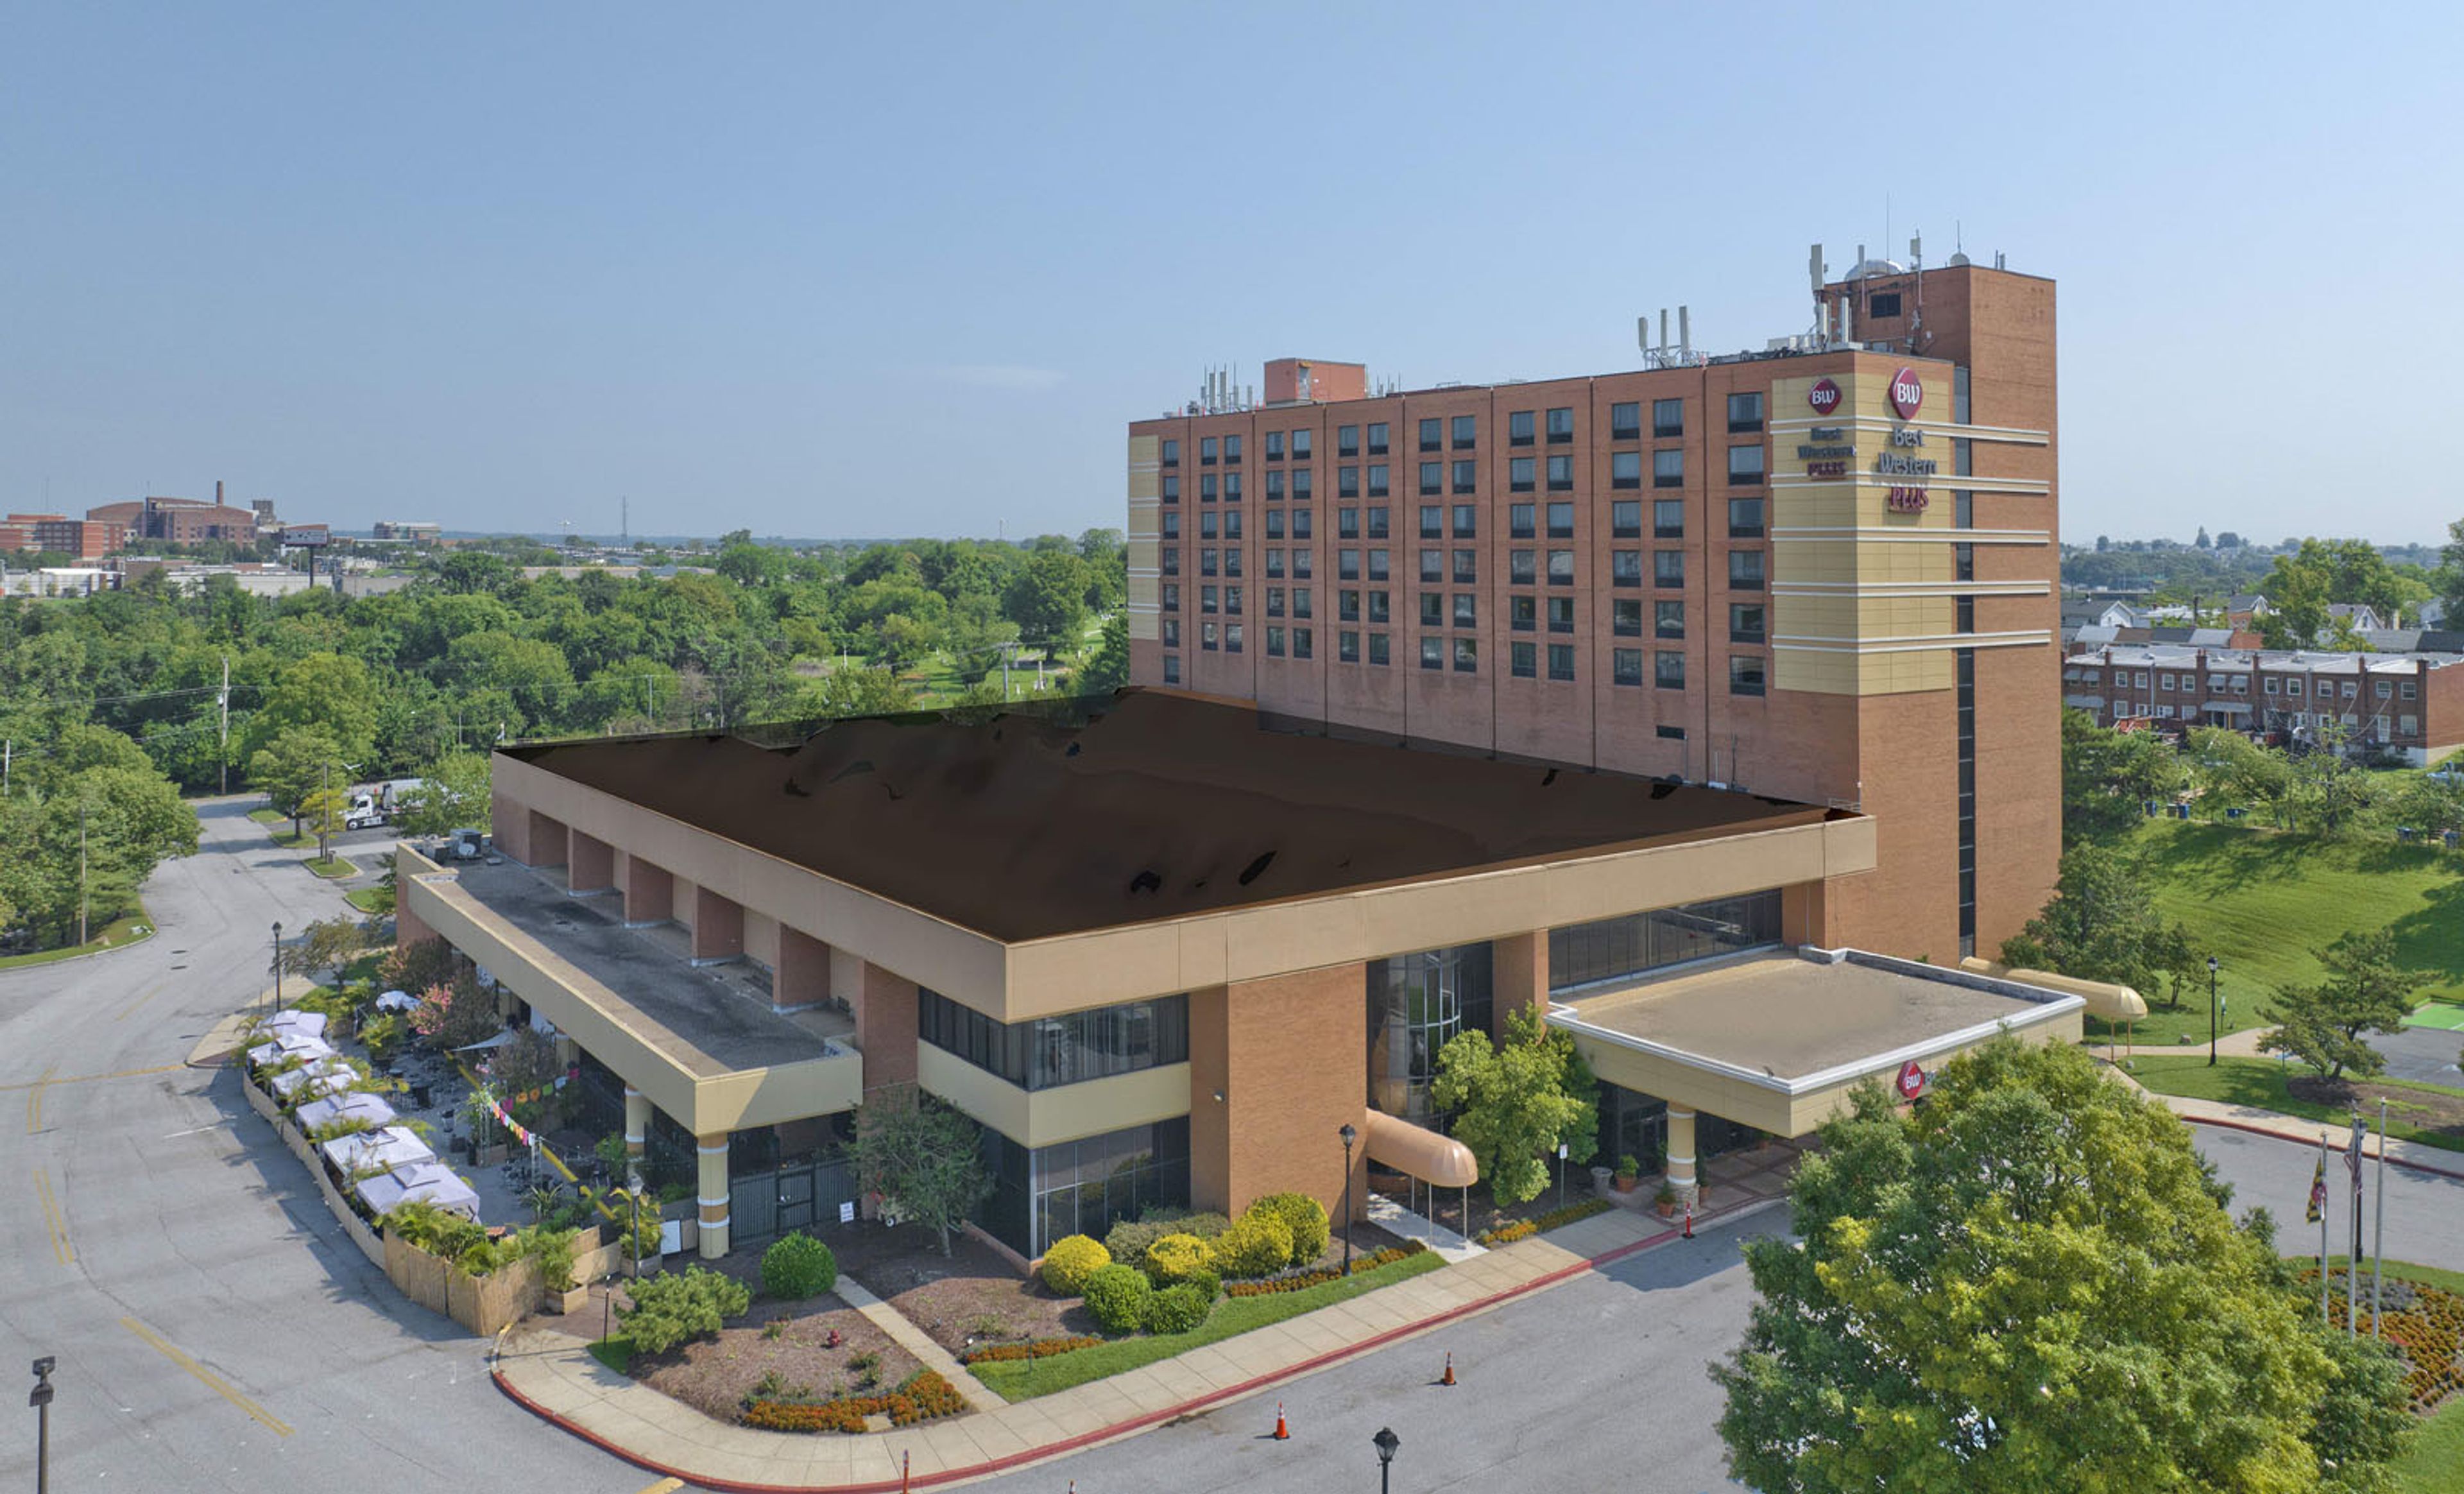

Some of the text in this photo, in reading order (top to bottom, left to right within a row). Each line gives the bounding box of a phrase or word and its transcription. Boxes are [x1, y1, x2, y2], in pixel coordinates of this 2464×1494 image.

[1812, 390, 1836, 405] BW
[1897, 382, 1921, 405] BW
[1894, 427, 1924, 447] Best
[1879, 452, 1937, 475] Western
[1890, 486, 1929, 509] PLUS
[1906, 1072, 1921, 1090] BW
